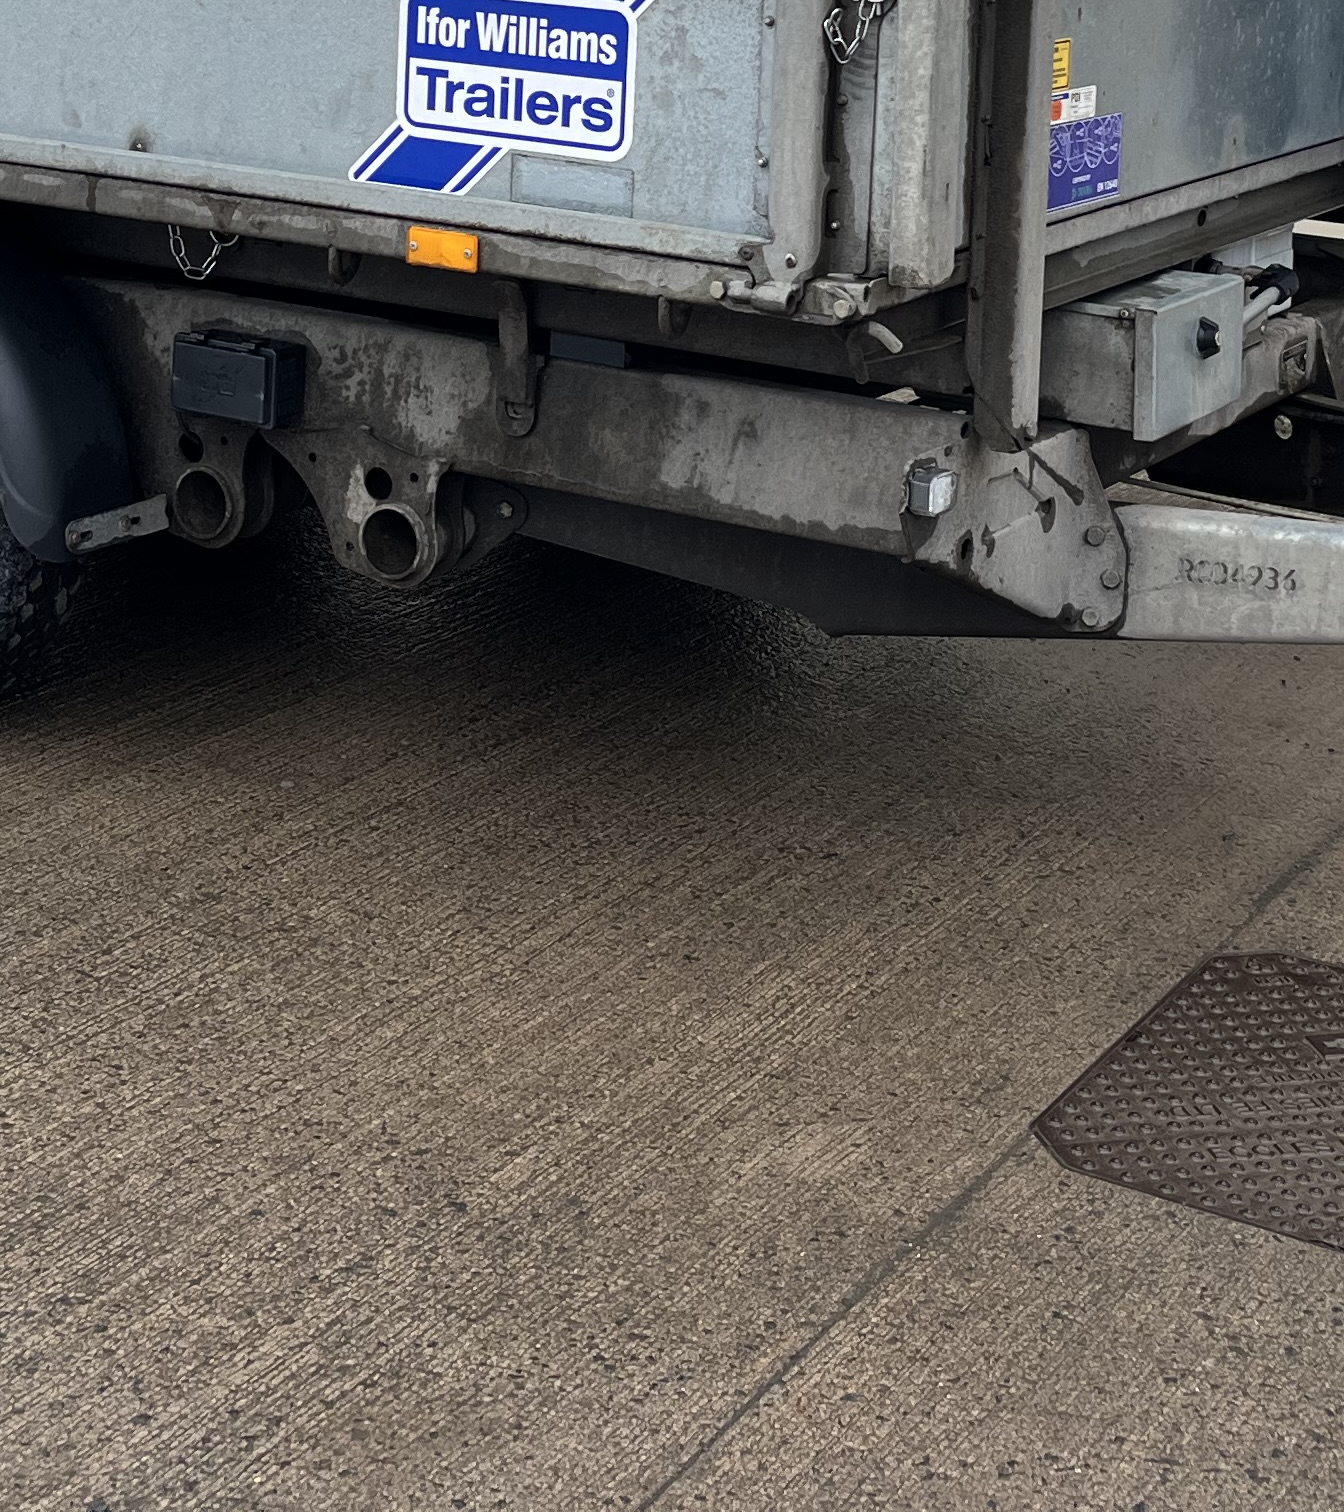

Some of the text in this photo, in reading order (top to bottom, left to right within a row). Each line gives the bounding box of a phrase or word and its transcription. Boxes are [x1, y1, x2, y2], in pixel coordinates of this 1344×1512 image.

[416, 5, 618, 66] Ifor Williams
[415, 66, 614, 133] Trailers
